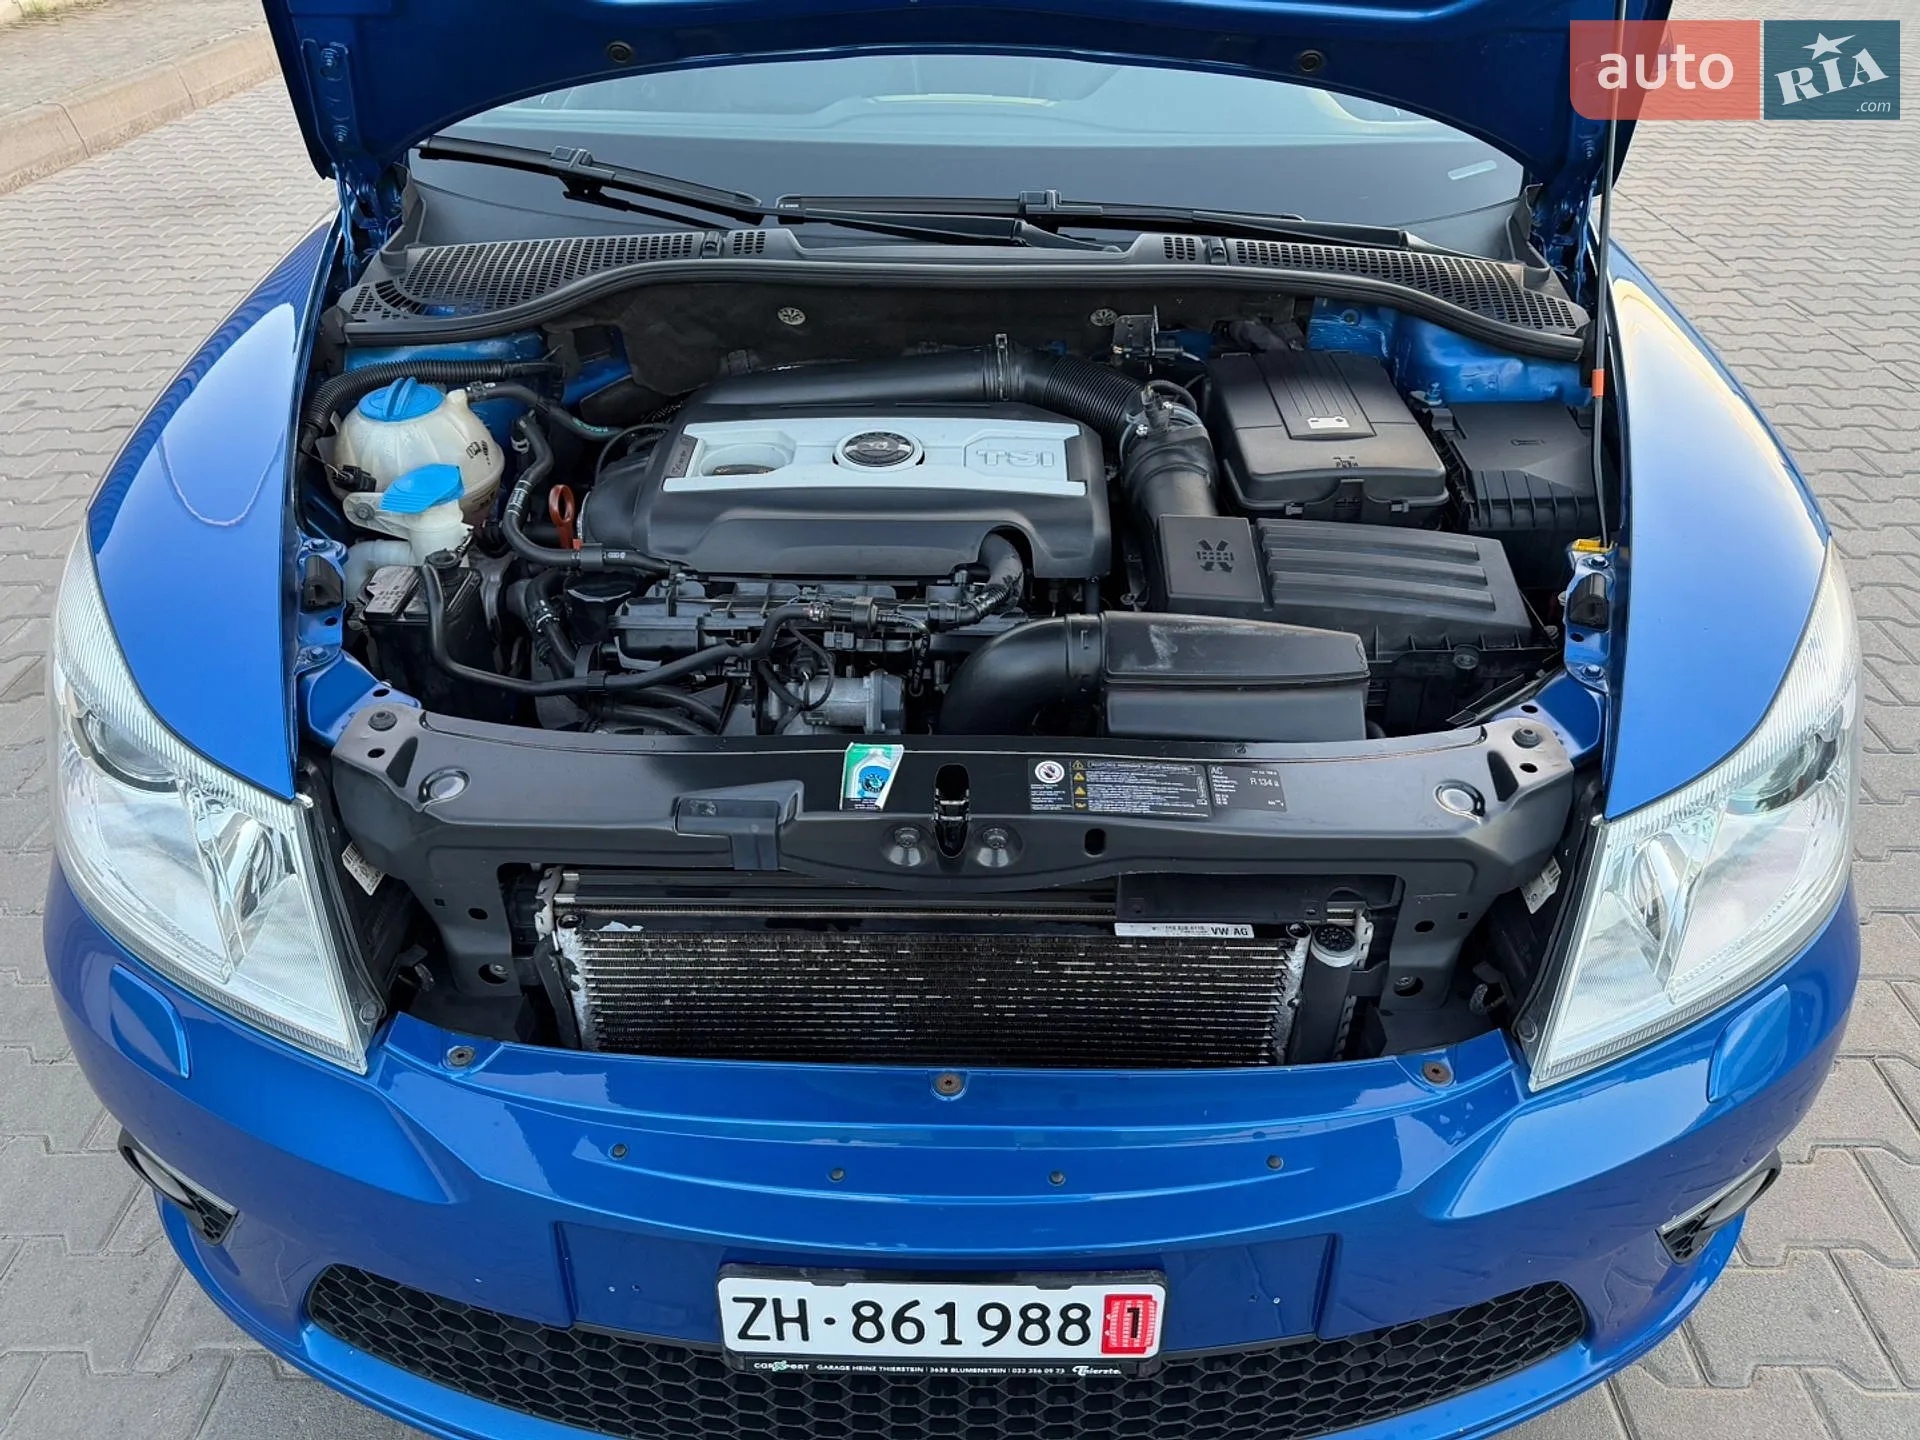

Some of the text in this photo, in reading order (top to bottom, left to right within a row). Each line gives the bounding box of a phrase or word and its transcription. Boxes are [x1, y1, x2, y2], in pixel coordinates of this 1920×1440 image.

[976, 450, 1054, 468] TSI
[1210, 927, 1229, 935] VW
[1234, 927, 1248, 935] AG
